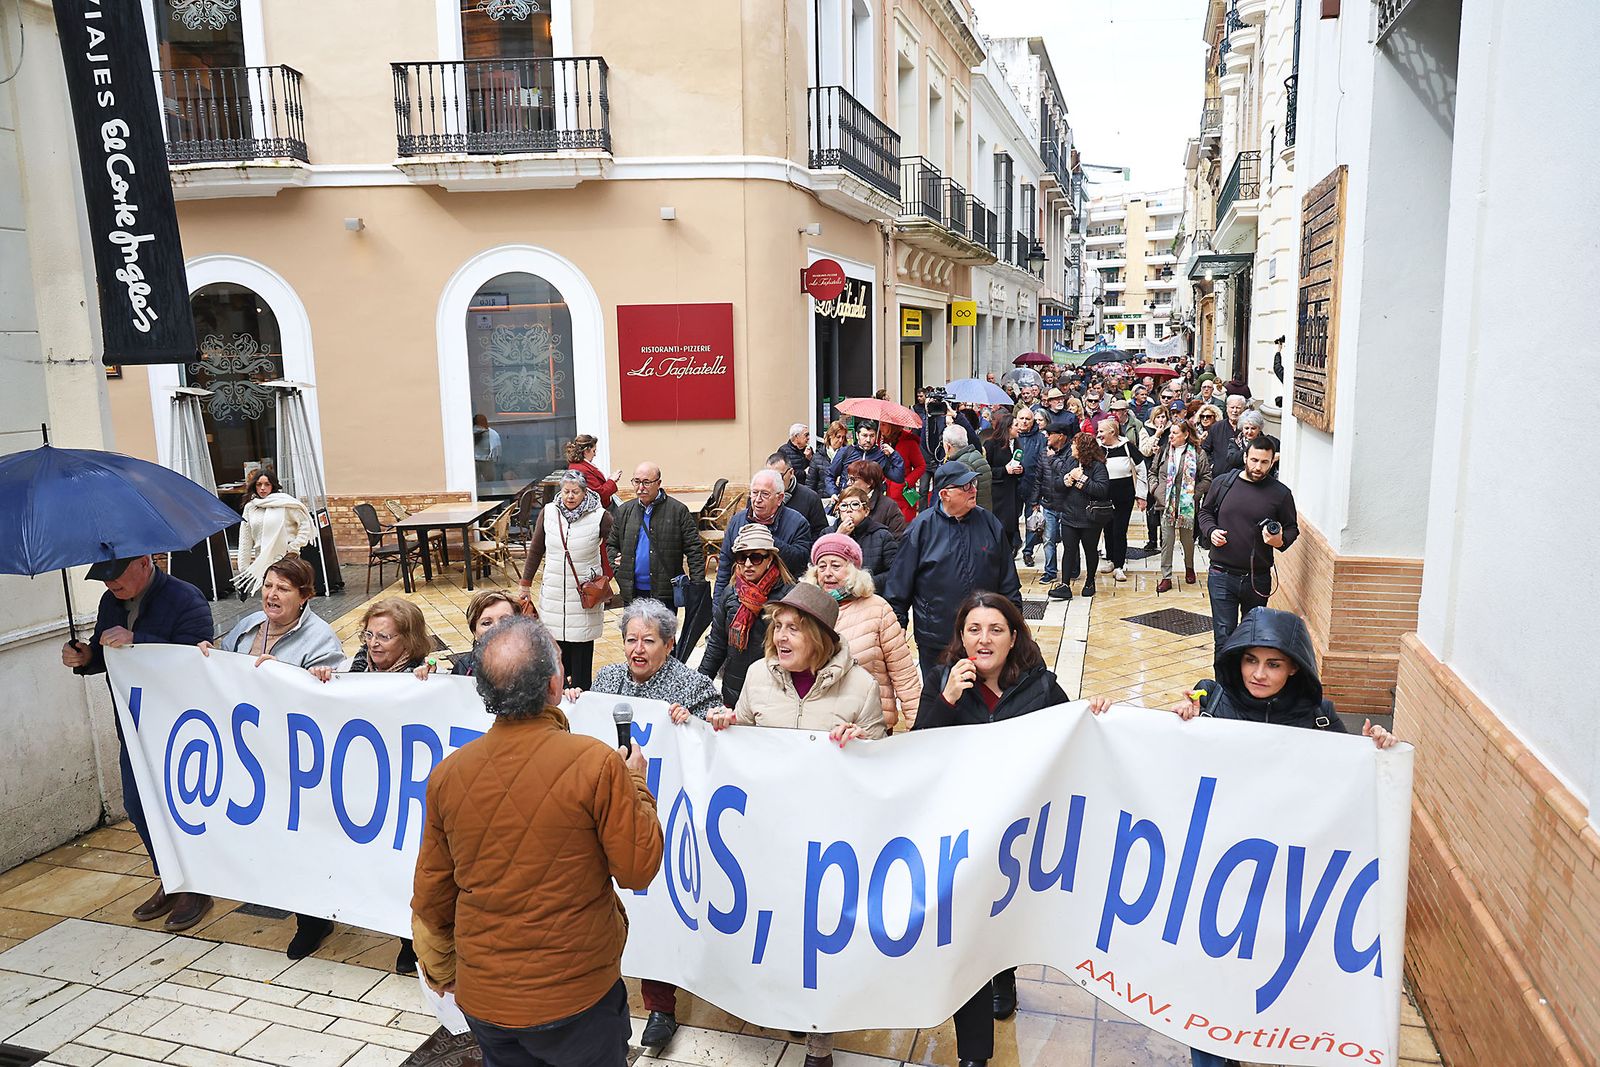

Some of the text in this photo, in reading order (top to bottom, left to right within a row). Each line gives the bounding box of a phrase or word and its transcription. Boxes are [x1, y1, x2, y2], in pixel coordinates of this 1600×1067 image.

[84, 0, 115, 108] IAJES
[101, 118, 159, 333] El Corte Inglés
[626, 355, 727, 379] La Tagliatella
[640, 344, 711, 354] RISTORANTI PIZZERIE
[129, 687, 266, 836] @S
[803, 829, 969, 990] por
[990, 794, 1086, 918] su
[1096, 776, 1383, 1014] playa
[1075, 959, 1385, 1065] AA.VV. Portileños
